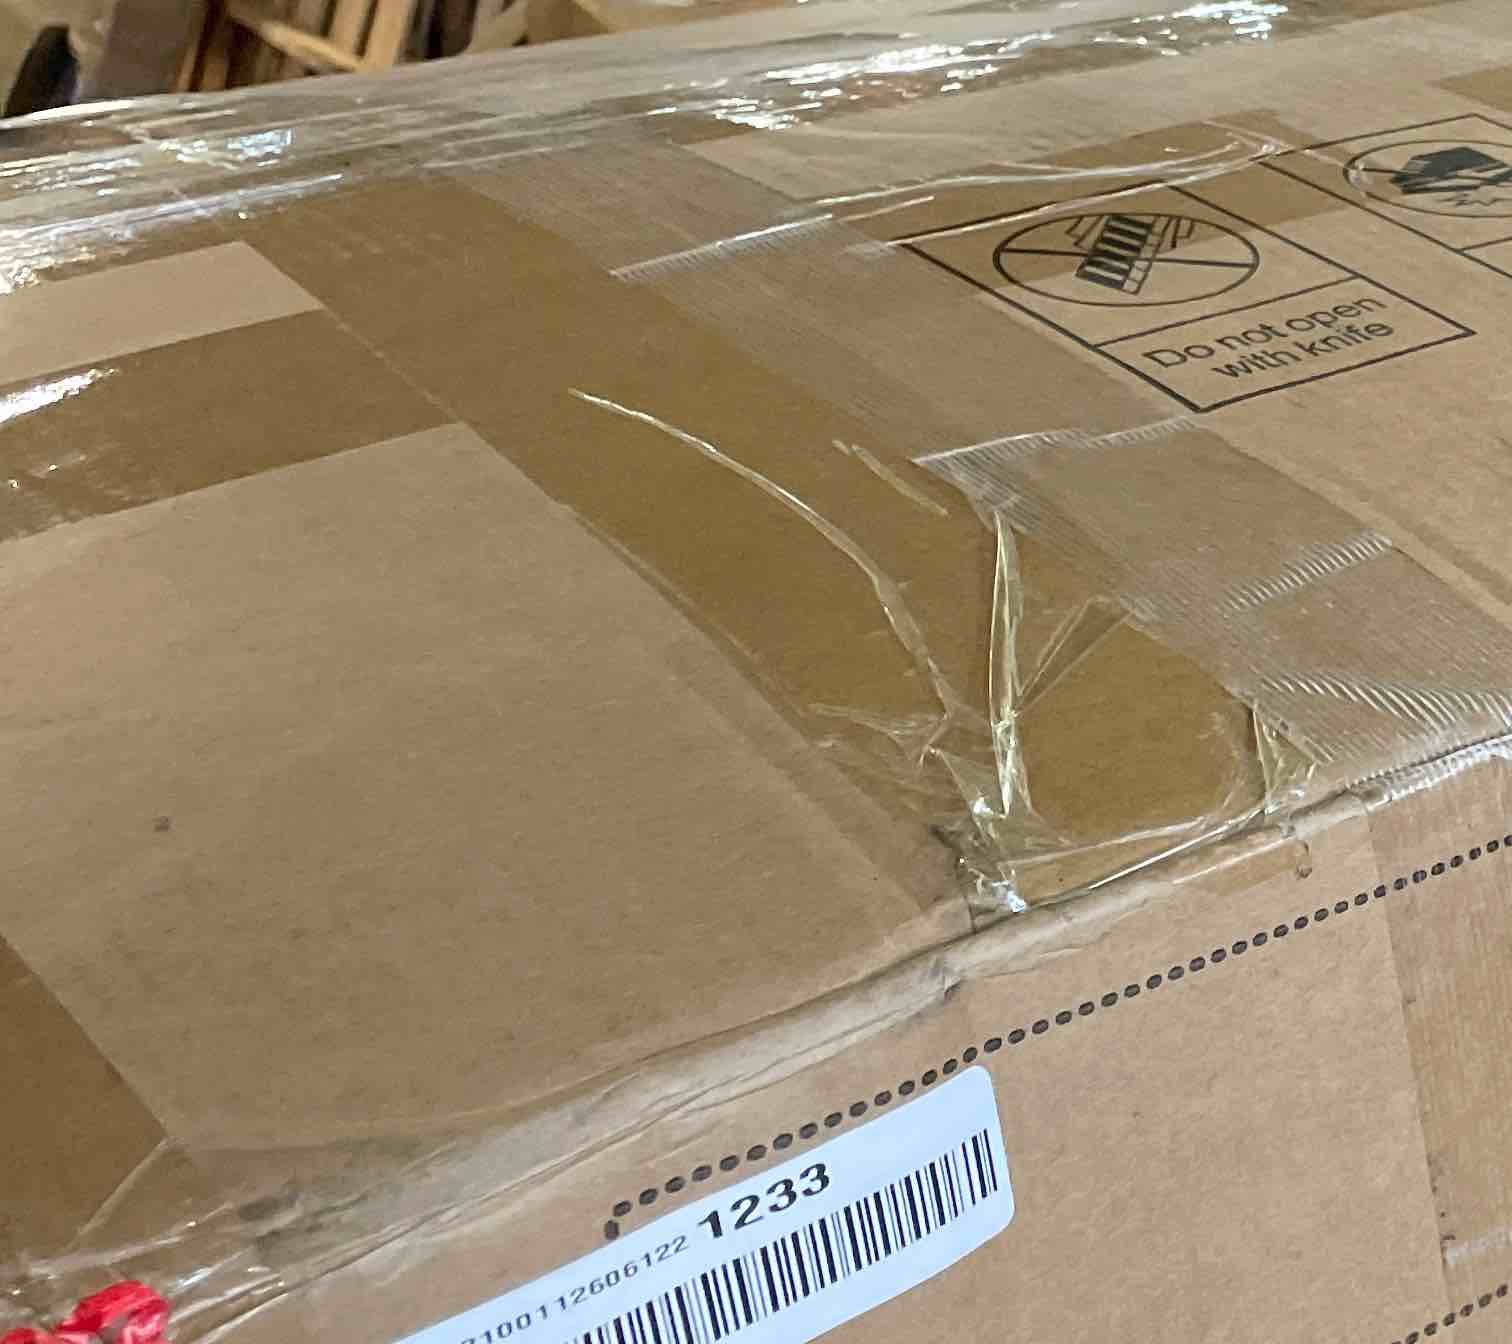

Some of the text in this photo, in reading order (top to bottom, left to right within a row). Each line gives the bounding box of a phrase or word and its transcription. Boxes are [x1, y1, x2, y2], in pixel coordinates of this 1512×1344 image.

[1142, 297, 1387, 367] Do not open
[1211, 323, 1394, 378] with knife
[697, 1163, 831, 1239] 1233
